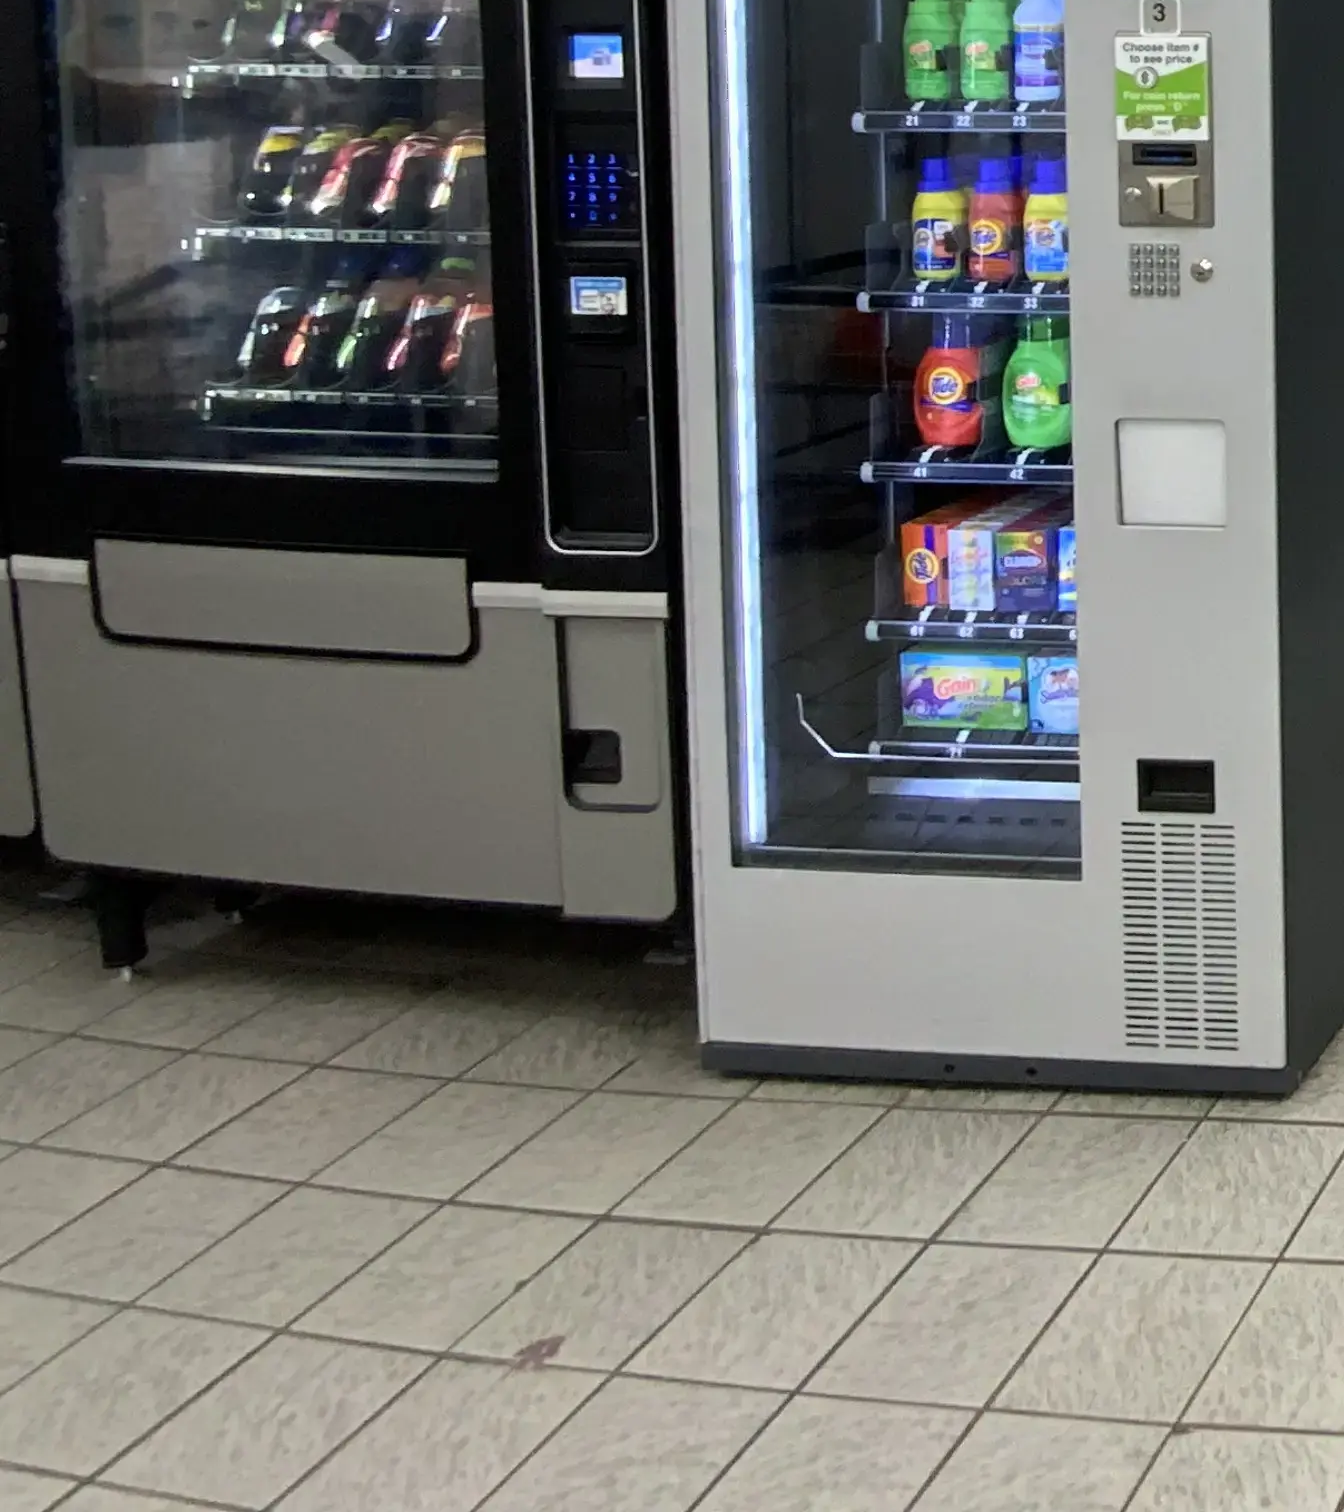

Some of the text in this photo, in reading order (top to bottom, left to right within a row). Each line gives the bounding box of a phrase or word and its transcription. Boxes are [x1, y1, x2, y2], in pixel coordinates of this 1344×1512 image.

[1152, 3, 1166, 22] 3
[1122, 42, 1164, 52] Choose
[1167, 42, 1190, 52] item
[1129, 55, 1140, 63] to
[1165, 54, 1193, 65] price
[1123, 91, 1140, 100] For
[1167, 92, 1200, 100] return
[905, 115, 1027, 126] 21 22 23
[970, 296, 985, 308] 32
[1024, 297, 1038, 309] 33
[932, 376, 958, 395] Tide
[913, 467, 1024, 480] 41 42
[1009, 627, 1024, 639] 63
[937, 677, 977, 697] Gain
